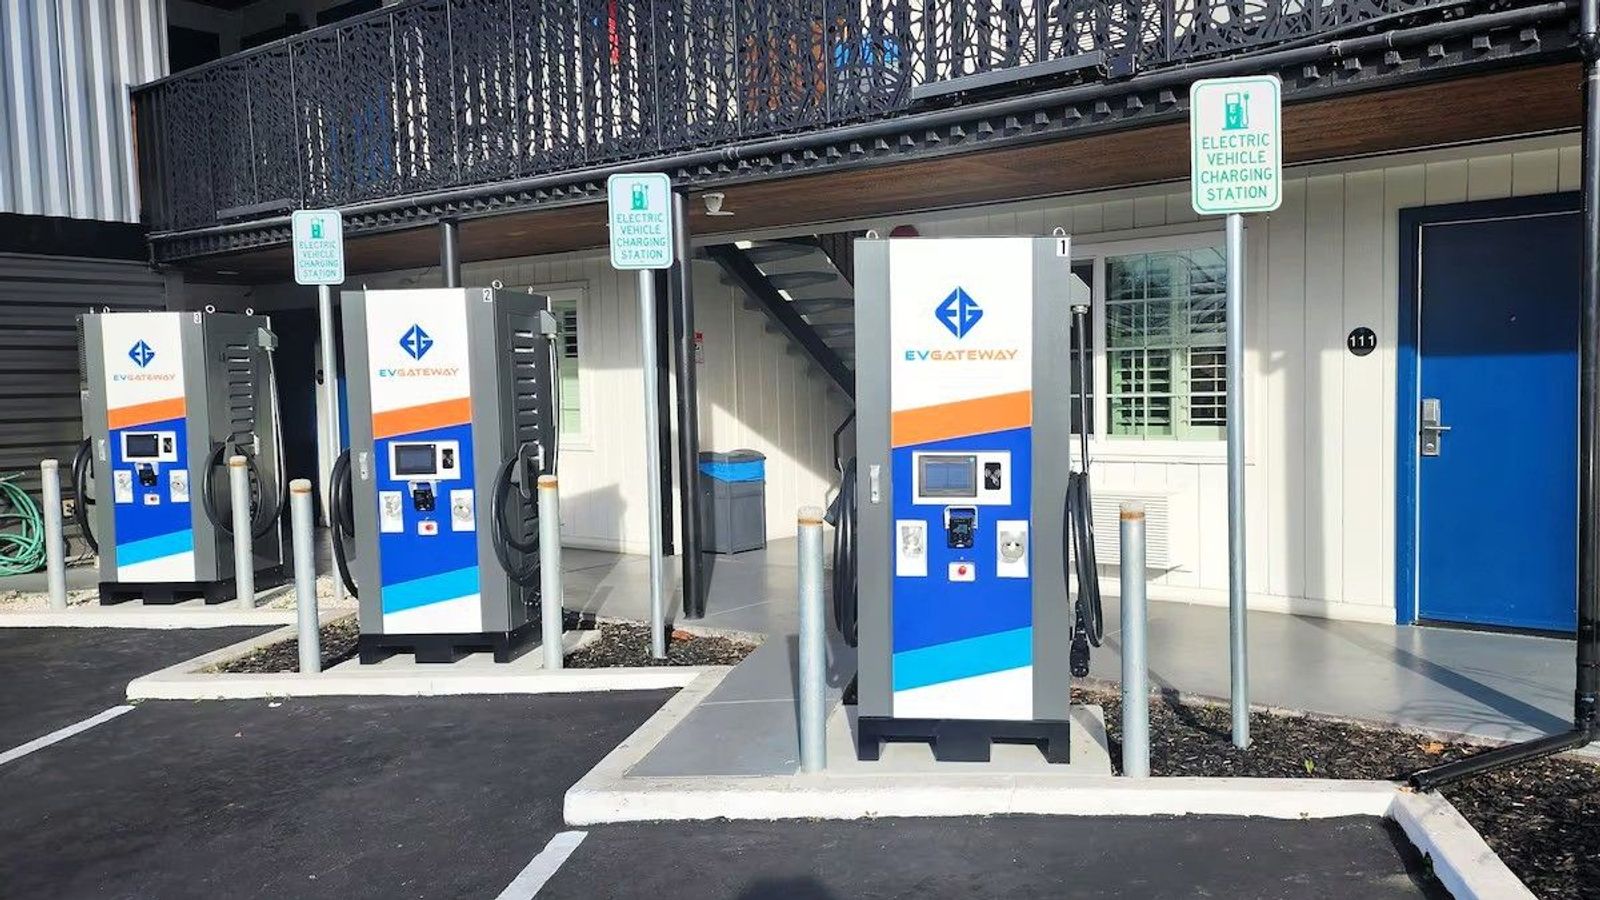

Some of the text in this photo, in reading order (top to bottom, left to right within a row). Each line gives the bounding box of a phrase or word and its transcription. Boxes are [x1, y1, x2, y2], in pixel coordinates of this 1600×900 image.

[1202, 133, 1270, 149] ELECTRIC
[1207, 150, 1267, 165] VEHICLE
[1201, 167, 1273, 184] CHARGING
[1207, 186, 1267, 201] STATION
[616, 213, 663, 224] ELECTRIC
[620, 224, 662, 235] VEHICLE
[617, 237, 666, 248] CHARGING
[1060, 239, 1066, 255] 1
[621, 249, 663, 260] STATION
[302, 269, 337, 279] STATION
[483, 289, 492, 302] 2
[1350, 335, 1374, 347] 111
[905, 349, 1018, 361] EVGATEWAY
[379, 367, 460, 377] EVGATEWAY
